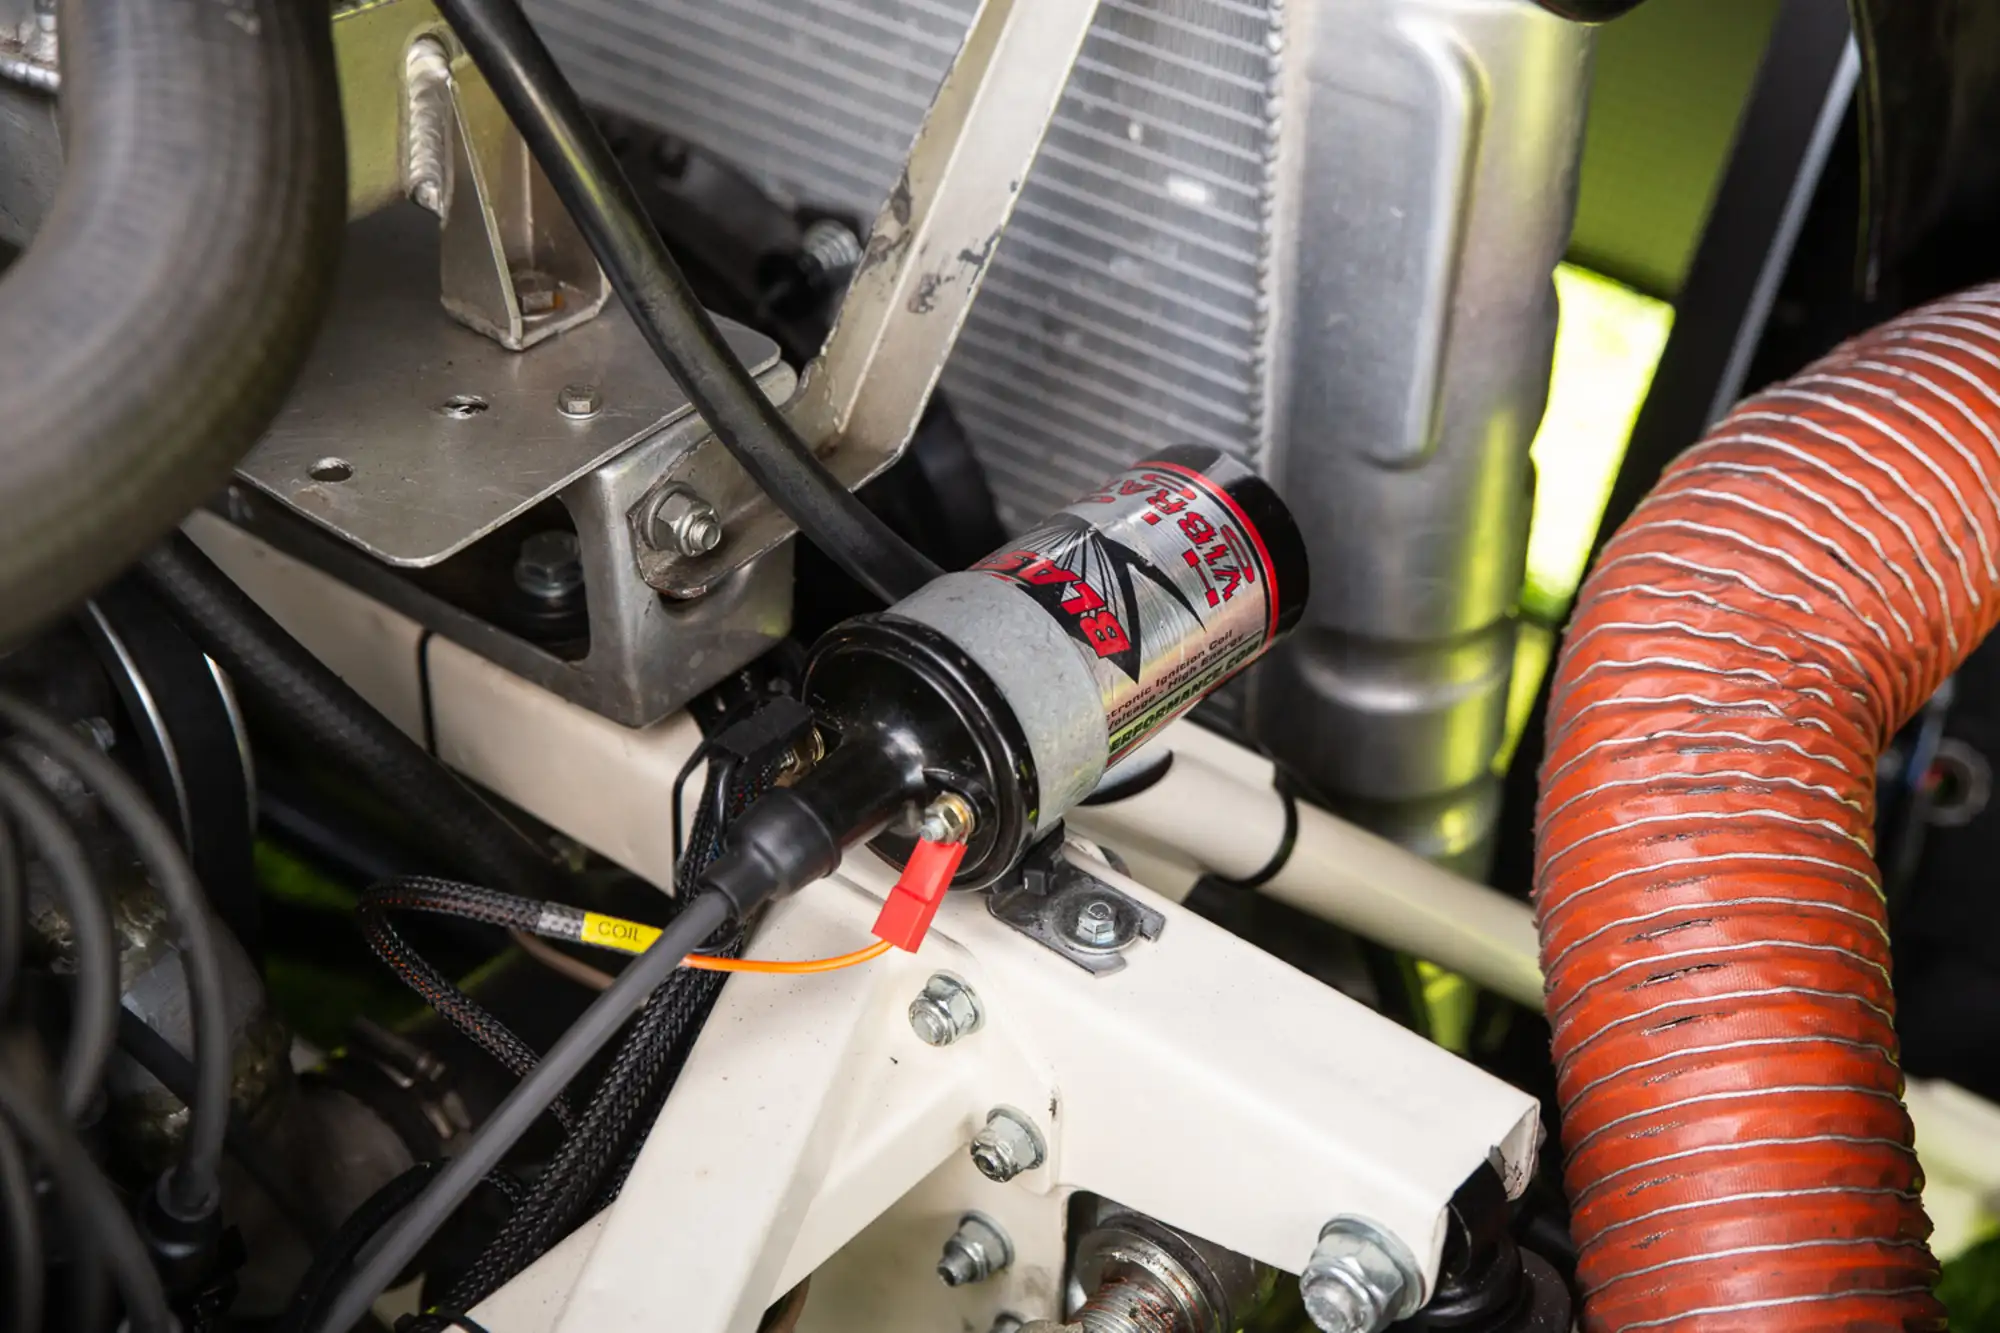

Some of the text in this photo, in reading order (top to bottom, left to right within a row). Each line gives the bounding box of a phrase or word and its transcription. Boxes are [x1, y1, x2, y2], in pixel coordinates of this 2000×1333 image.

[966, 549, 1131, 659] BLAS
[1155, 650, 1205, 688] Ignition
[1208, 629, 1233, 651] Coil
[1167, 665, 1198, 690] High
[1200, 633, 1244, 668] Energy
[598, 920, 642, 943] COIL
